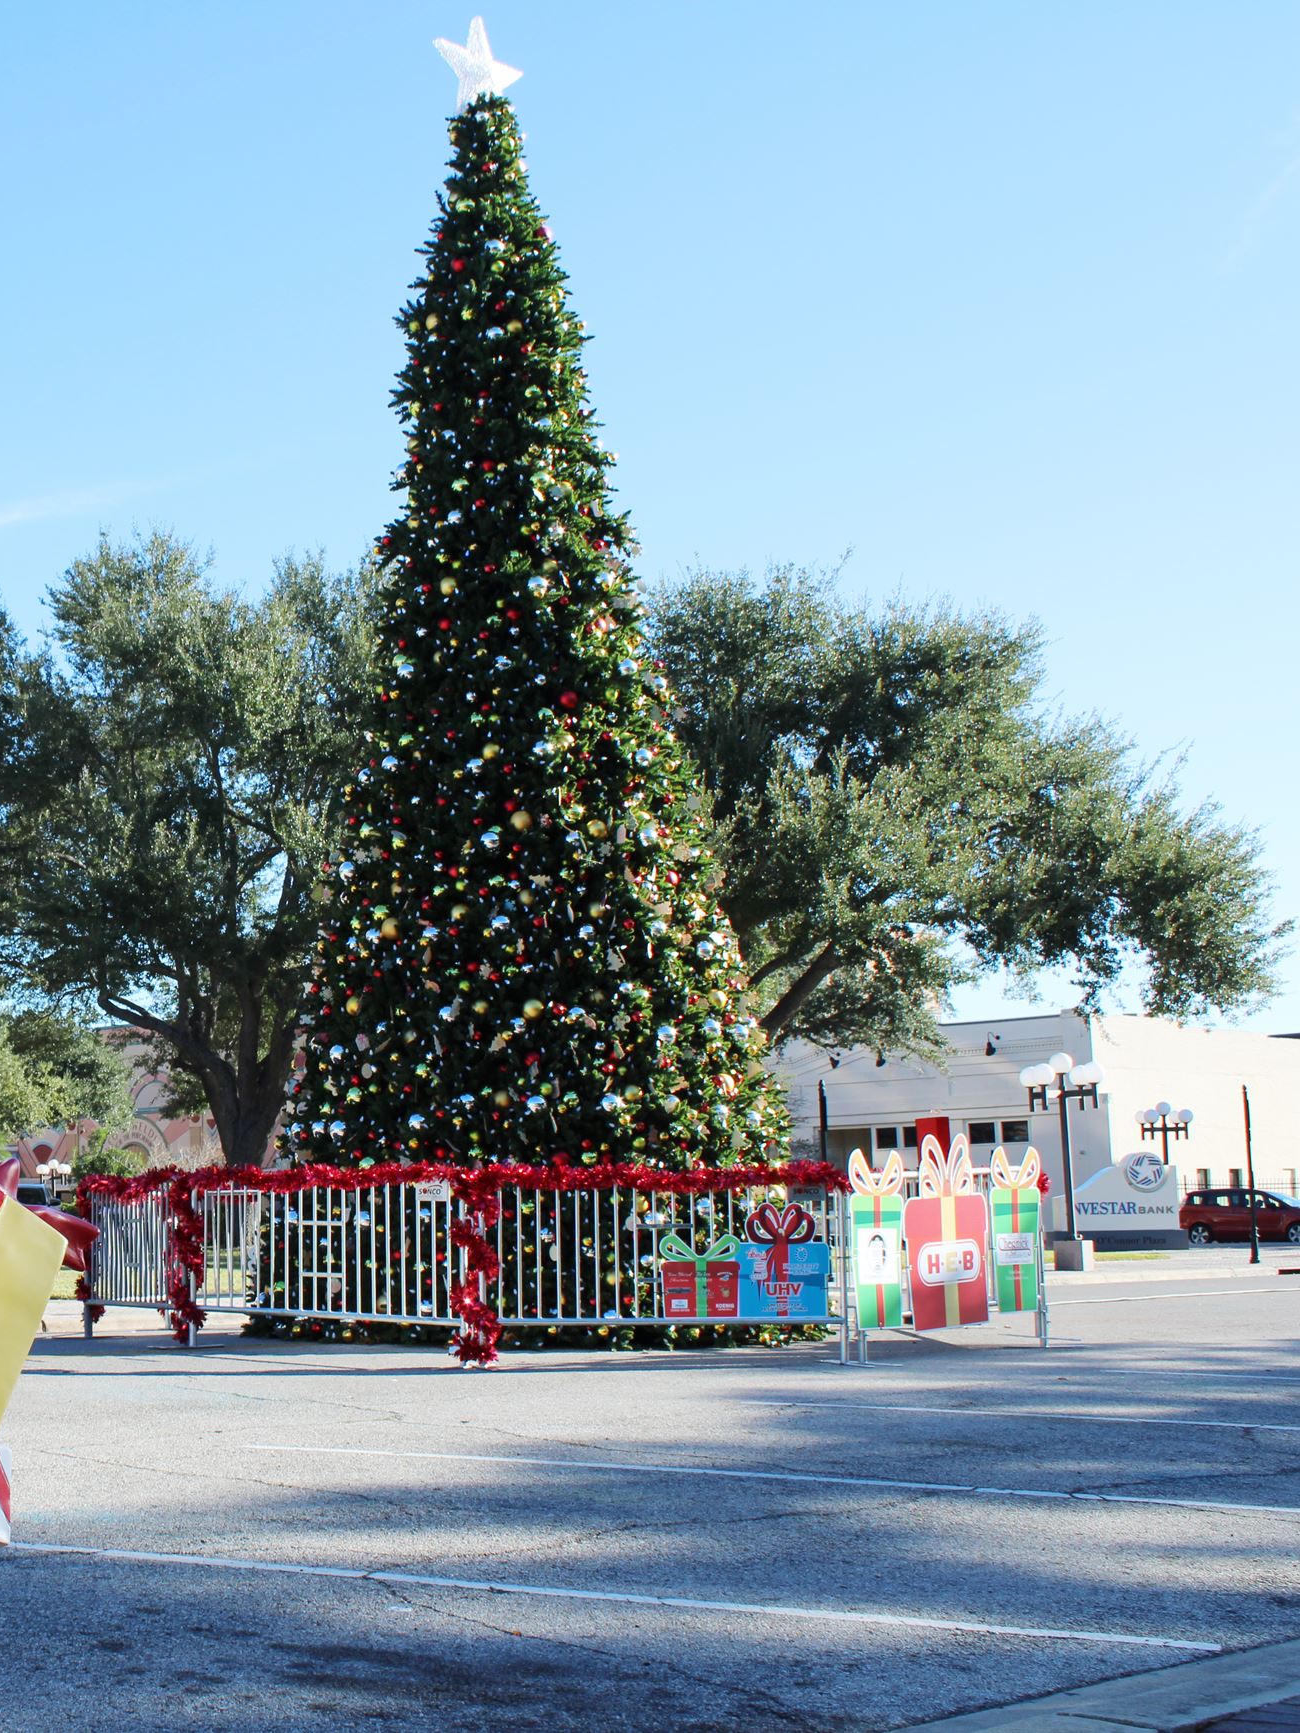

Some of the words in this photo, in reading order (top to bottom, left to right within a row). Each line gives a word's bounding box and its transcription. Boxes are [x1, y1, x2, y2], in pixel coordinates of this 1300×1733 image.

[1074, 1201, 1137, 1216] NVESTAR
[1137, 1205, 1174, 1215] BANK
[1142, 1236, 1167, 1245] Plaza
[766, 1283, 803, 1296] UHV
